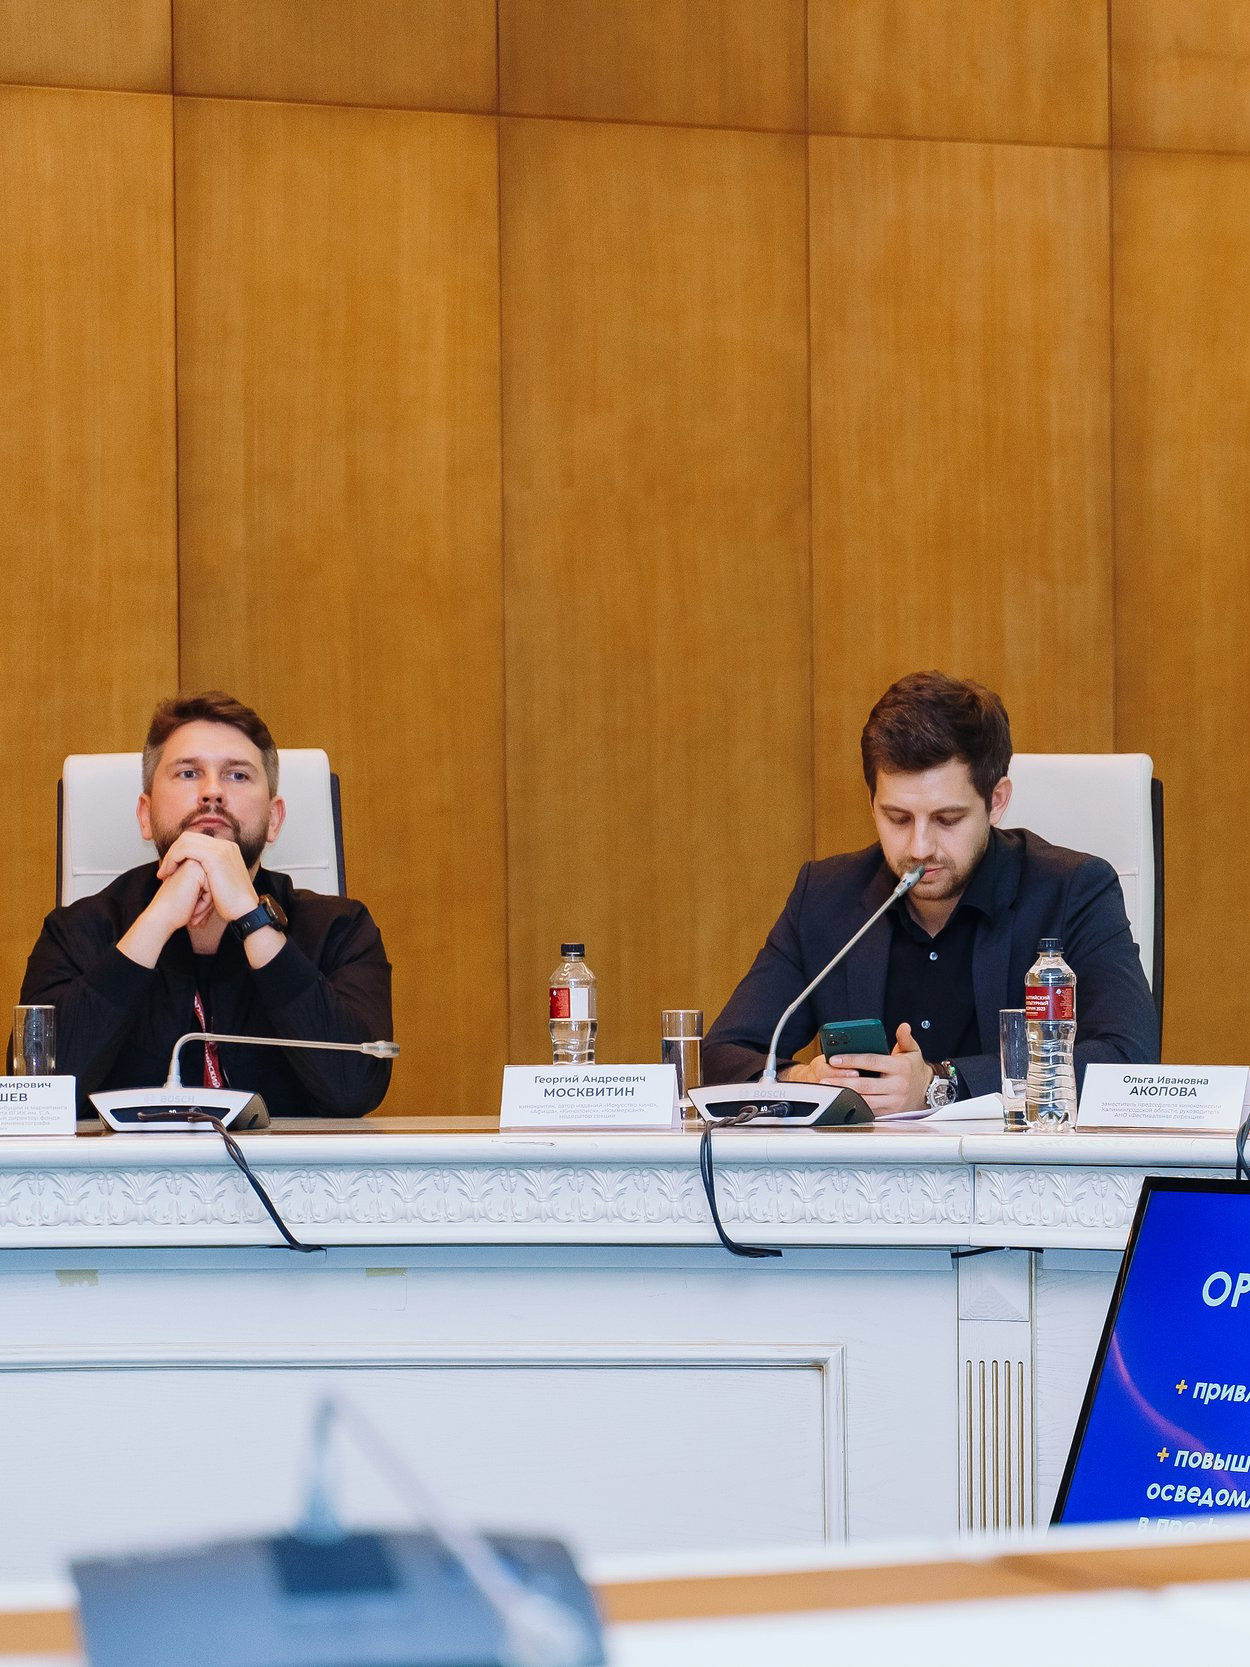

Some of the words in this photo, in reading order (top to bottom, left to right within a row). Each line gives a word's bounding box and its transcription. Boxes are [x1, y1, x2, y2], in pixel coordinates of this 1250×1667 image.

[534, 1074, 579, 1084] Георгий
[582, 1075, 646, 1084] Андреевич
[1123, 1075, 1153, 1085] Ольга
[1157, 1076, 1209, 1085] Ивановна
[544, 1087, 635, 1097] МОСКВИТИН
[753, 1090, 786, 1098] BOSCH
[1129, 1086, 1197, 1097] АКОПОВА
[161, 1095, 195, 1103] BOSCH
